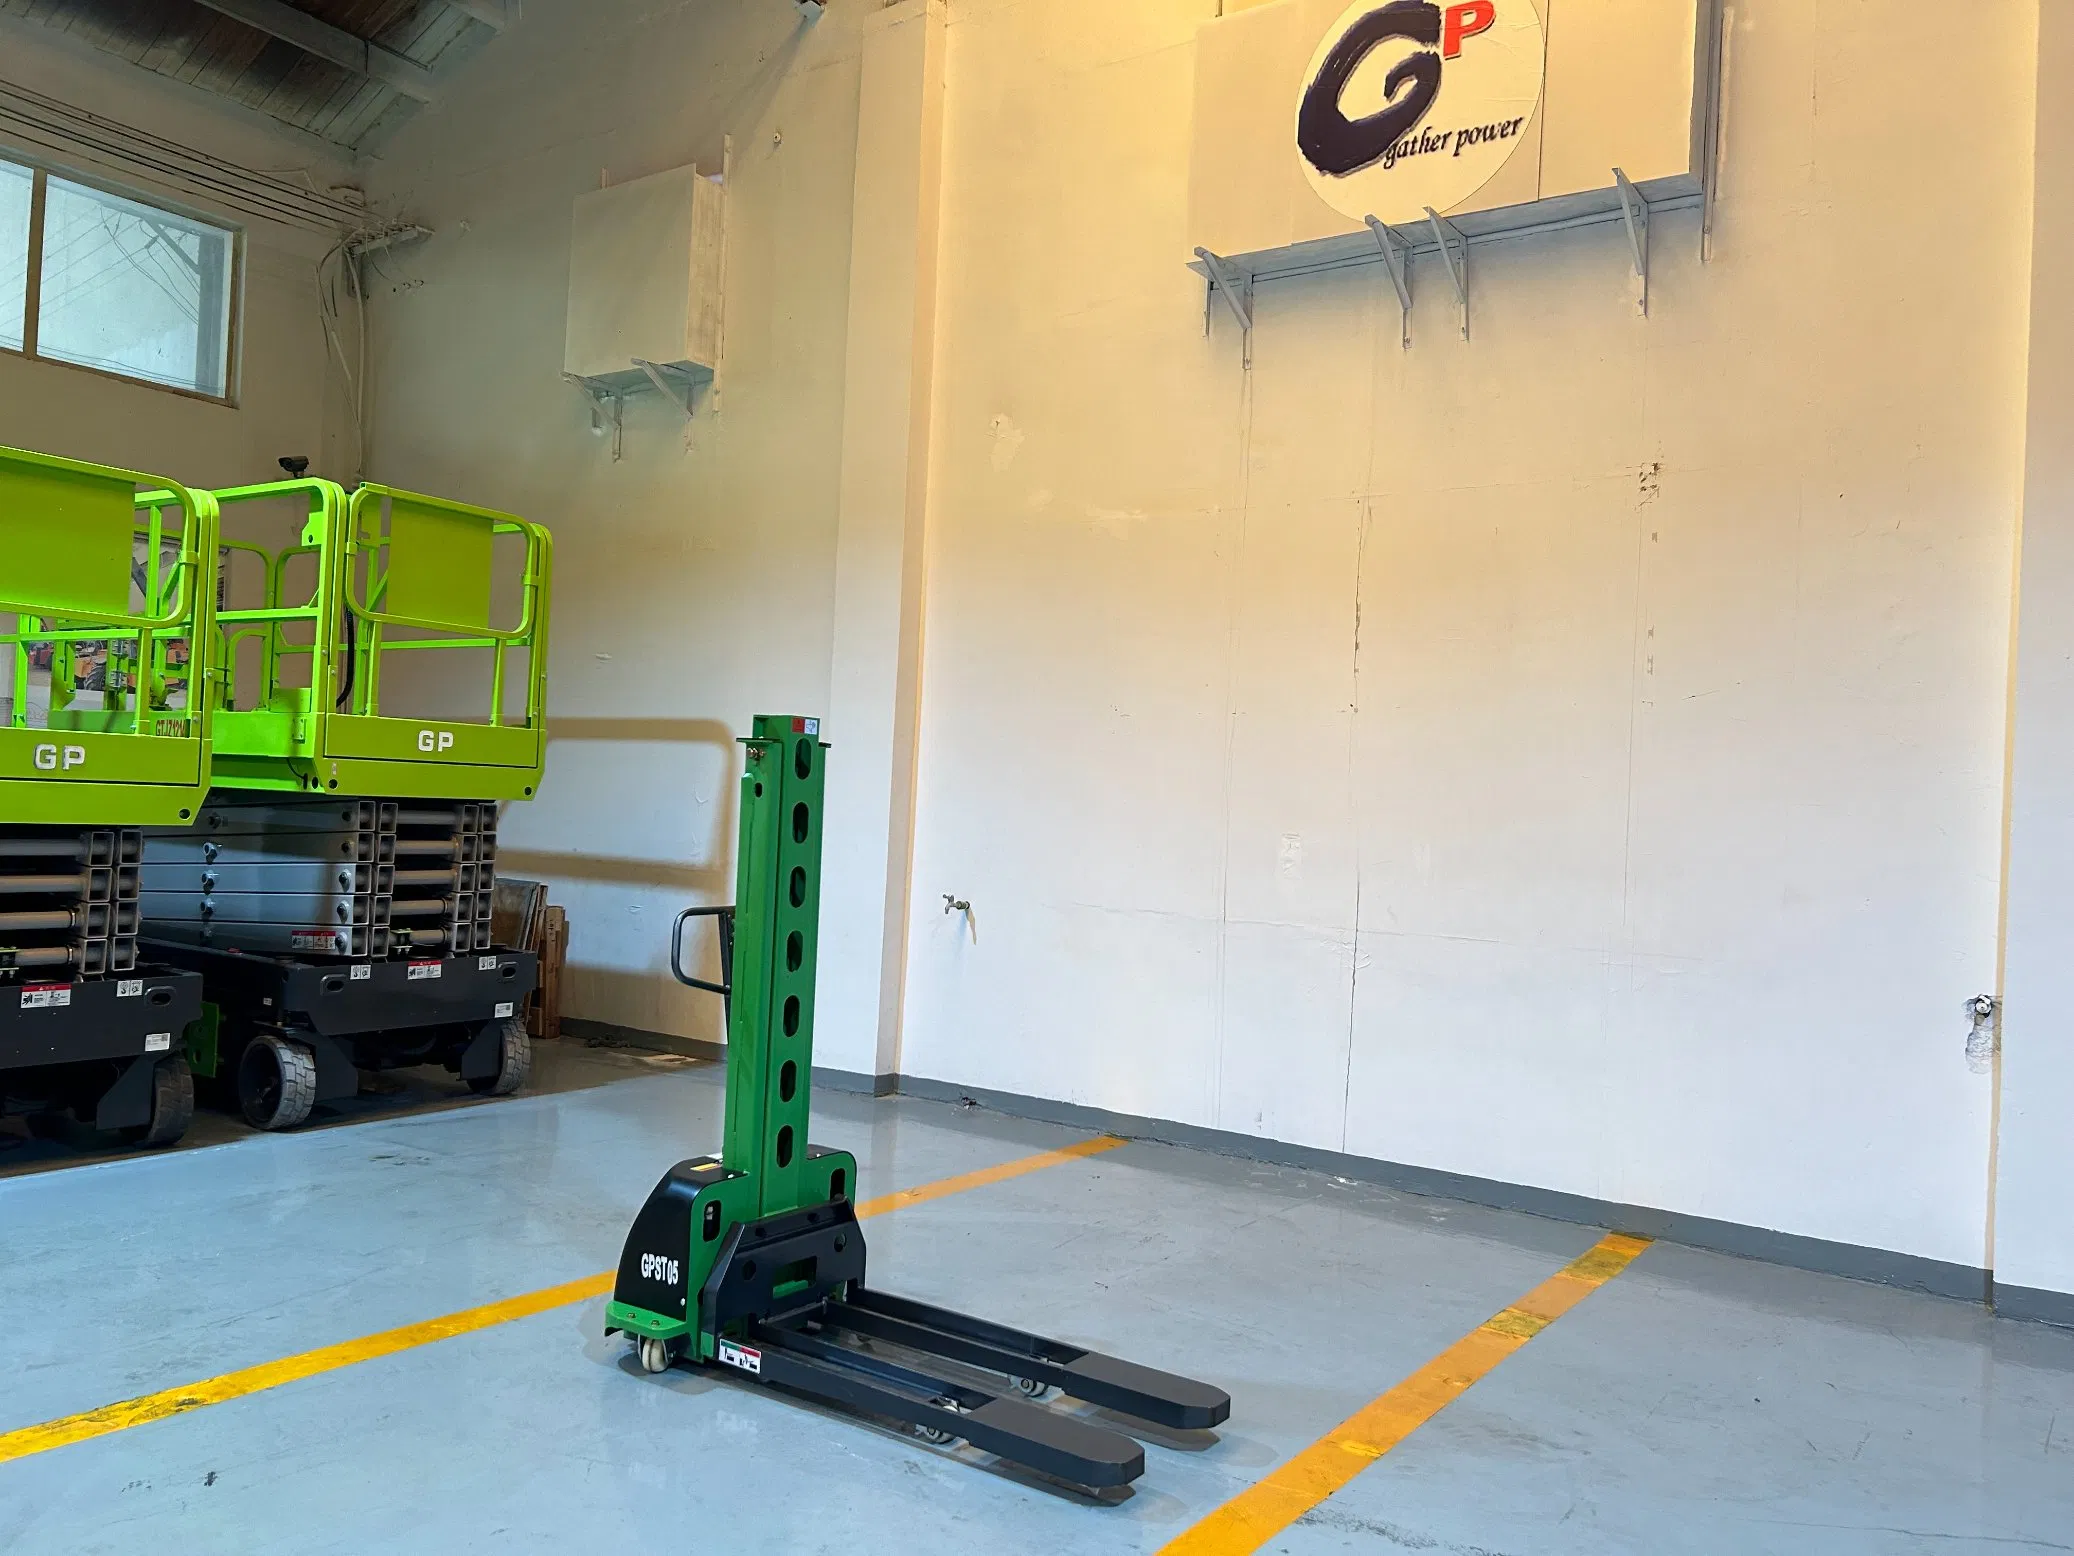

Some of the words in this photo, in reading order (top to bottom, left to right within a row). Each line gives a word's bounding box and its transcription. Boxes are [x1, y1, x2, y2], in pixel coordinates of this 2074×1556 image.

[1383, 126, 1452, 169] gather
[1453, 116, 1524, 157] power
[418, 730, 454, 752] GP
[35, 744, 85, 770] GP
[641, 1252, 679, 1285] GPST05
